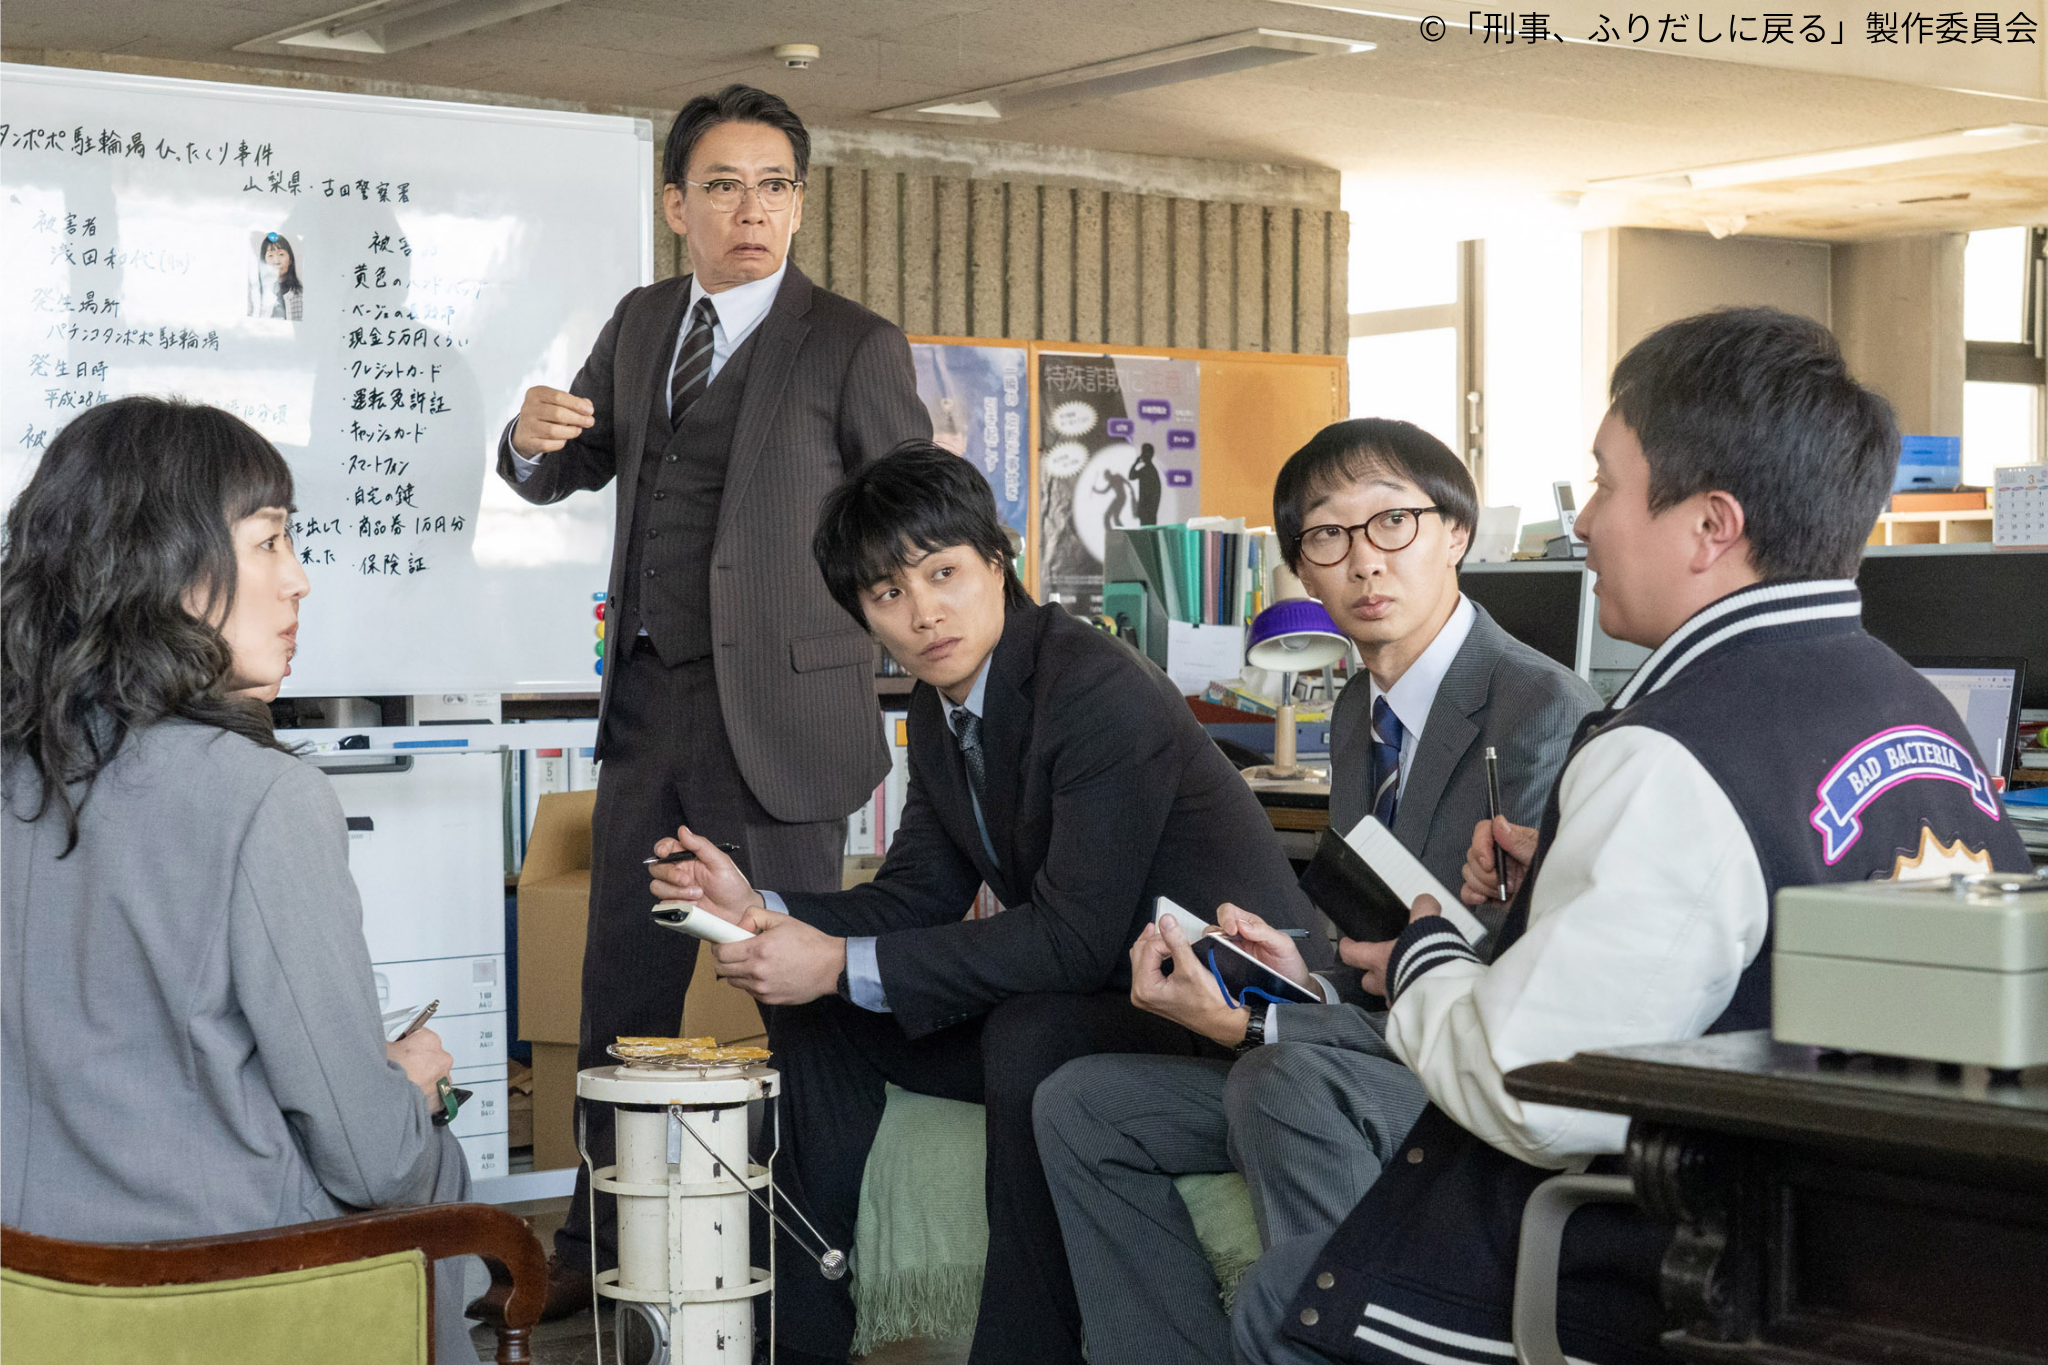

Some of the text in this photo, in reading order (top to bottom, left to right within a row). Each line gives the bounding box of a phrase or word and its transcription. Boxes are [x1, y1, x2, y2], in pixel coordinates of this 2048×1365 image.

[33, 209, 98, 237] 被害者
[30, 287, 120, 318] 発生場所
[46, 322, 220, 352] パチンコタンポポ駐輪場
[29, 352, 110, 382] 発生日時
[350, 360, 442, 382] クレジットカード
[350, 388, 452, 415] 運転免許証
[350, 420, 427, 443] キャッシュカード
[348, 455, 410, 476] スマートフォン
[354, 483, 420, 509] 自宅の鍵
[359, 553, 430, 575] 保険証
[546, 766, 553, 777] 5
[1846, 741, 1962, 795] BAD BACTERIA
